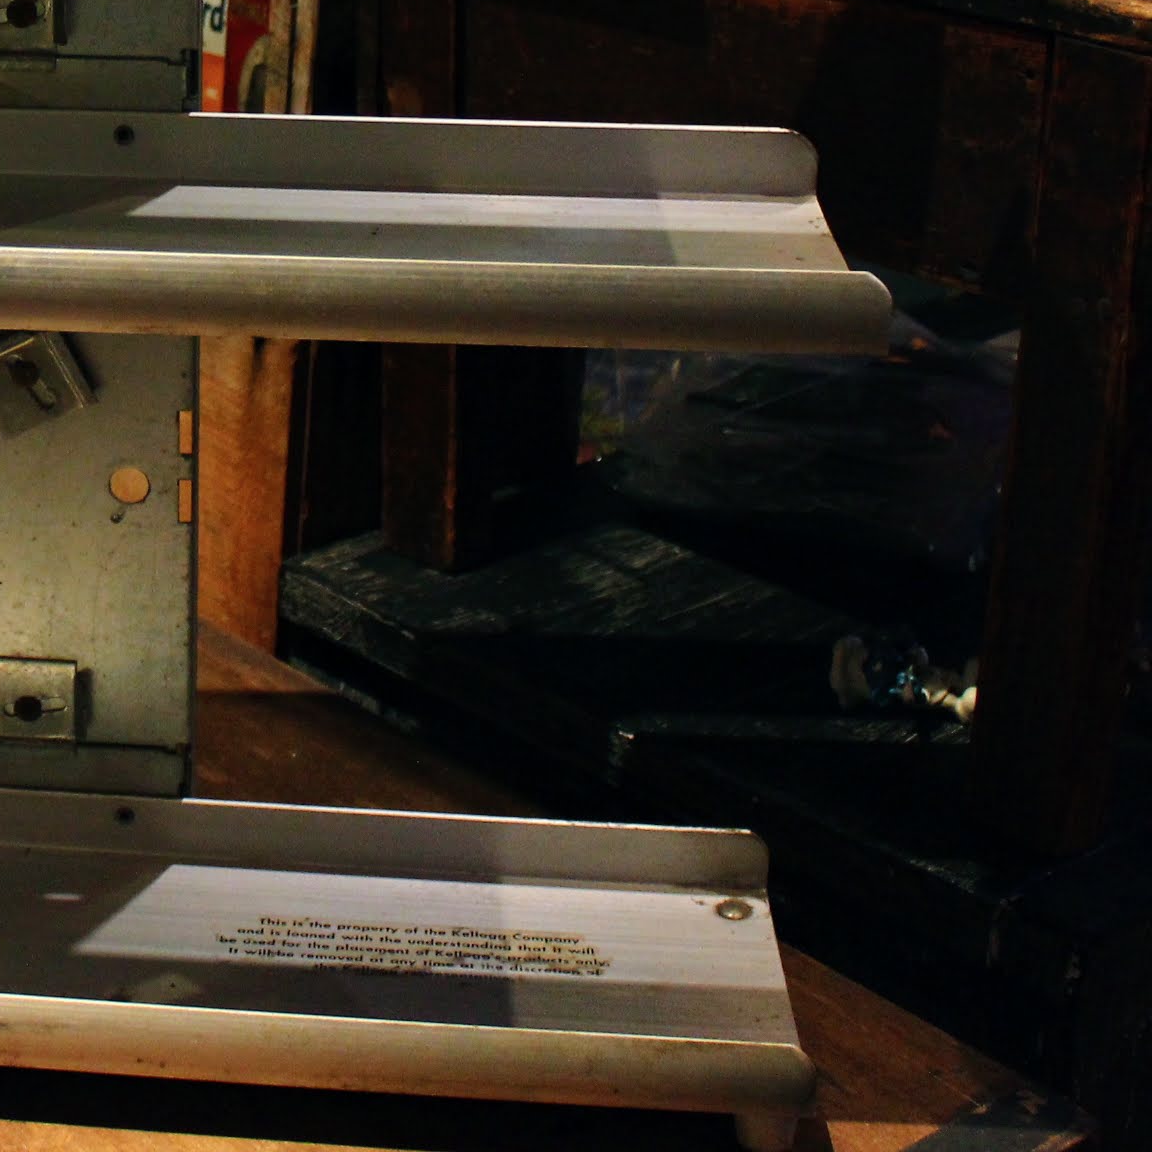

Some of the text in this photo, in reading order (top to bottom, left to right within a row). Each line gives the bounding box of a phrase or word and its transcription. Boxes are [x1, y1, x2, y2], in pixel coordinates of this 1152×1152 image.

[260, 917, 580, 945] This is the property of the Kellogg Company
[287, 930, 335, 940] loaned
[341, 934, 373, 942] with
[407, 939, 512, 952] understanding
[518, 944, 546, 952] that
[568, 947, 595, 955] will
[244, 949, 271, 957] will
[301, 953, 363, 962] removed
[423, 959, 454, 967] time
[481, 962, 503, 970] the
[509, 964, 581, 975] discretion
[586, 968, 601, 976] of
[308, 942, 330, 950] the
[336, 944, 410, 955] placement
[435, 950, 501, 961] Kellogg's
[507, 955, 569, 965] products
